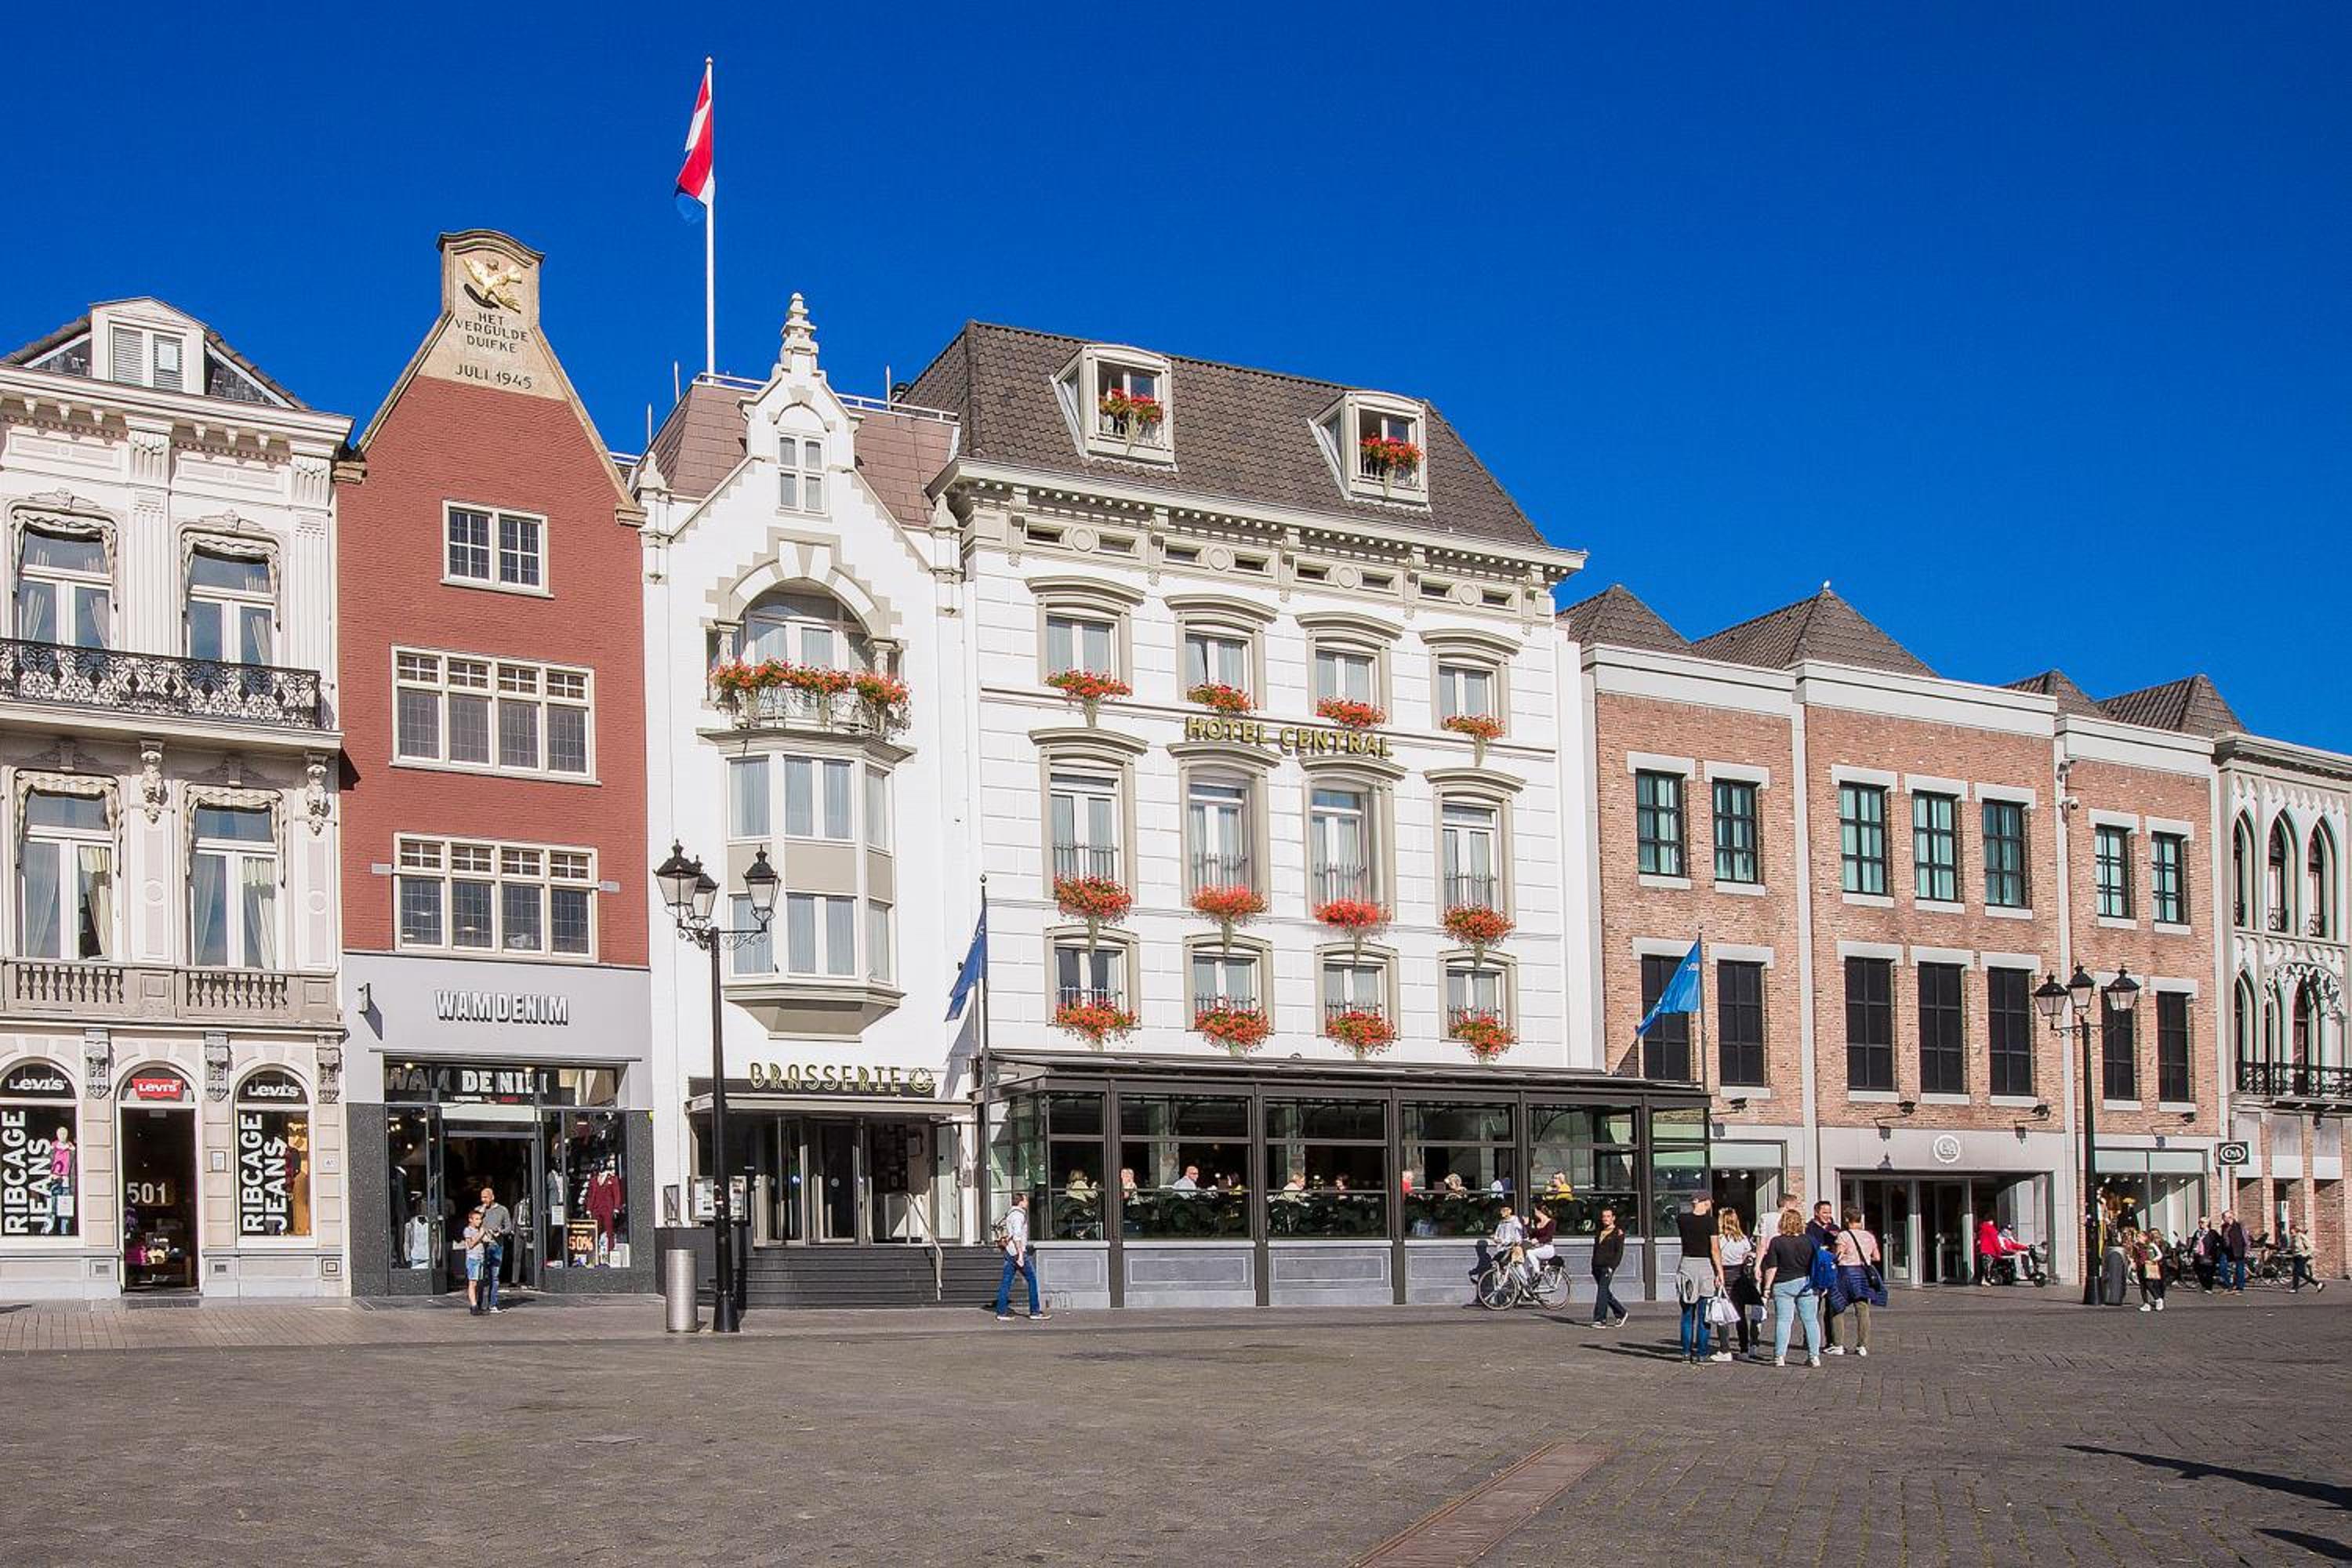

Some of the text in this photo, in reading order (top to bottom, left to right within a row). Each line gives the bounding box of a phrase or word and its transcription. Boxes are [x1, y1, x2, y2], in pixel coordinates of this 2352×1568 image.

[455, 318, 528, 343] VERGULDE
[478, 312, 504, 326] HET
[466, 335, 517, 353] DUIFKE
[455, 364, 532, 389] JULI 1945
[1185, 717, 1392, 757] HOTEL CENTRAL
[750, 1062, 901, 1092] BRASSERIE
[2, 1111, 28, 1233] RIBCAGE
[240, 1113, 264, 1232] RIBCAGE
[263, 1136, 289, 1231] JEANS
[27, 1138, 55, 1234] JEANS
[126, 1181, 166, 1204] 501
[568, 1236, 593, 1251] 50%
